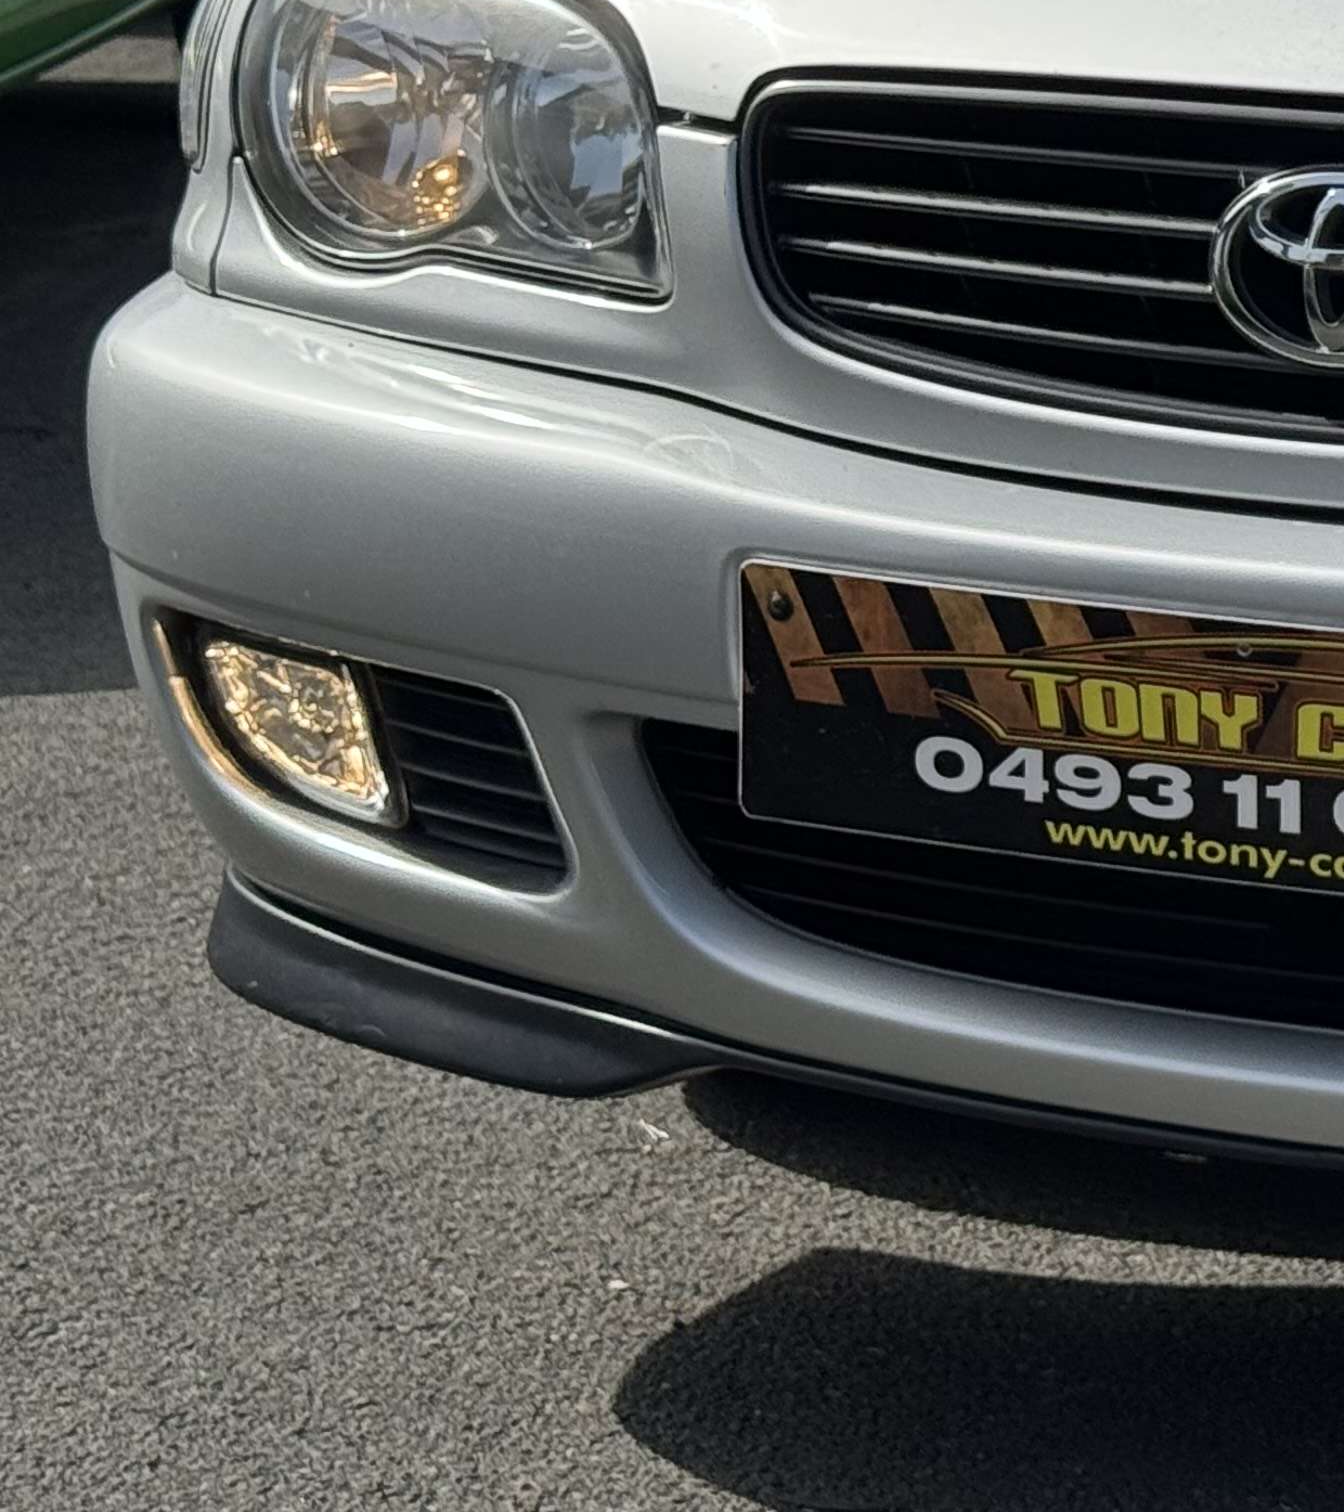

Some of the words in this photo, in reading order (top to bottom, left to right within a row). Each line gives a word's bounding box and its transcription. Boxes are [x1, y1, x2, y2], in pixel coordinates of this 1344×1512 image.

[1009, 669, 1260, 751] TONY
[914, 735, 1195, 821] 0493
[1223, 772, 1302, 835] 11
